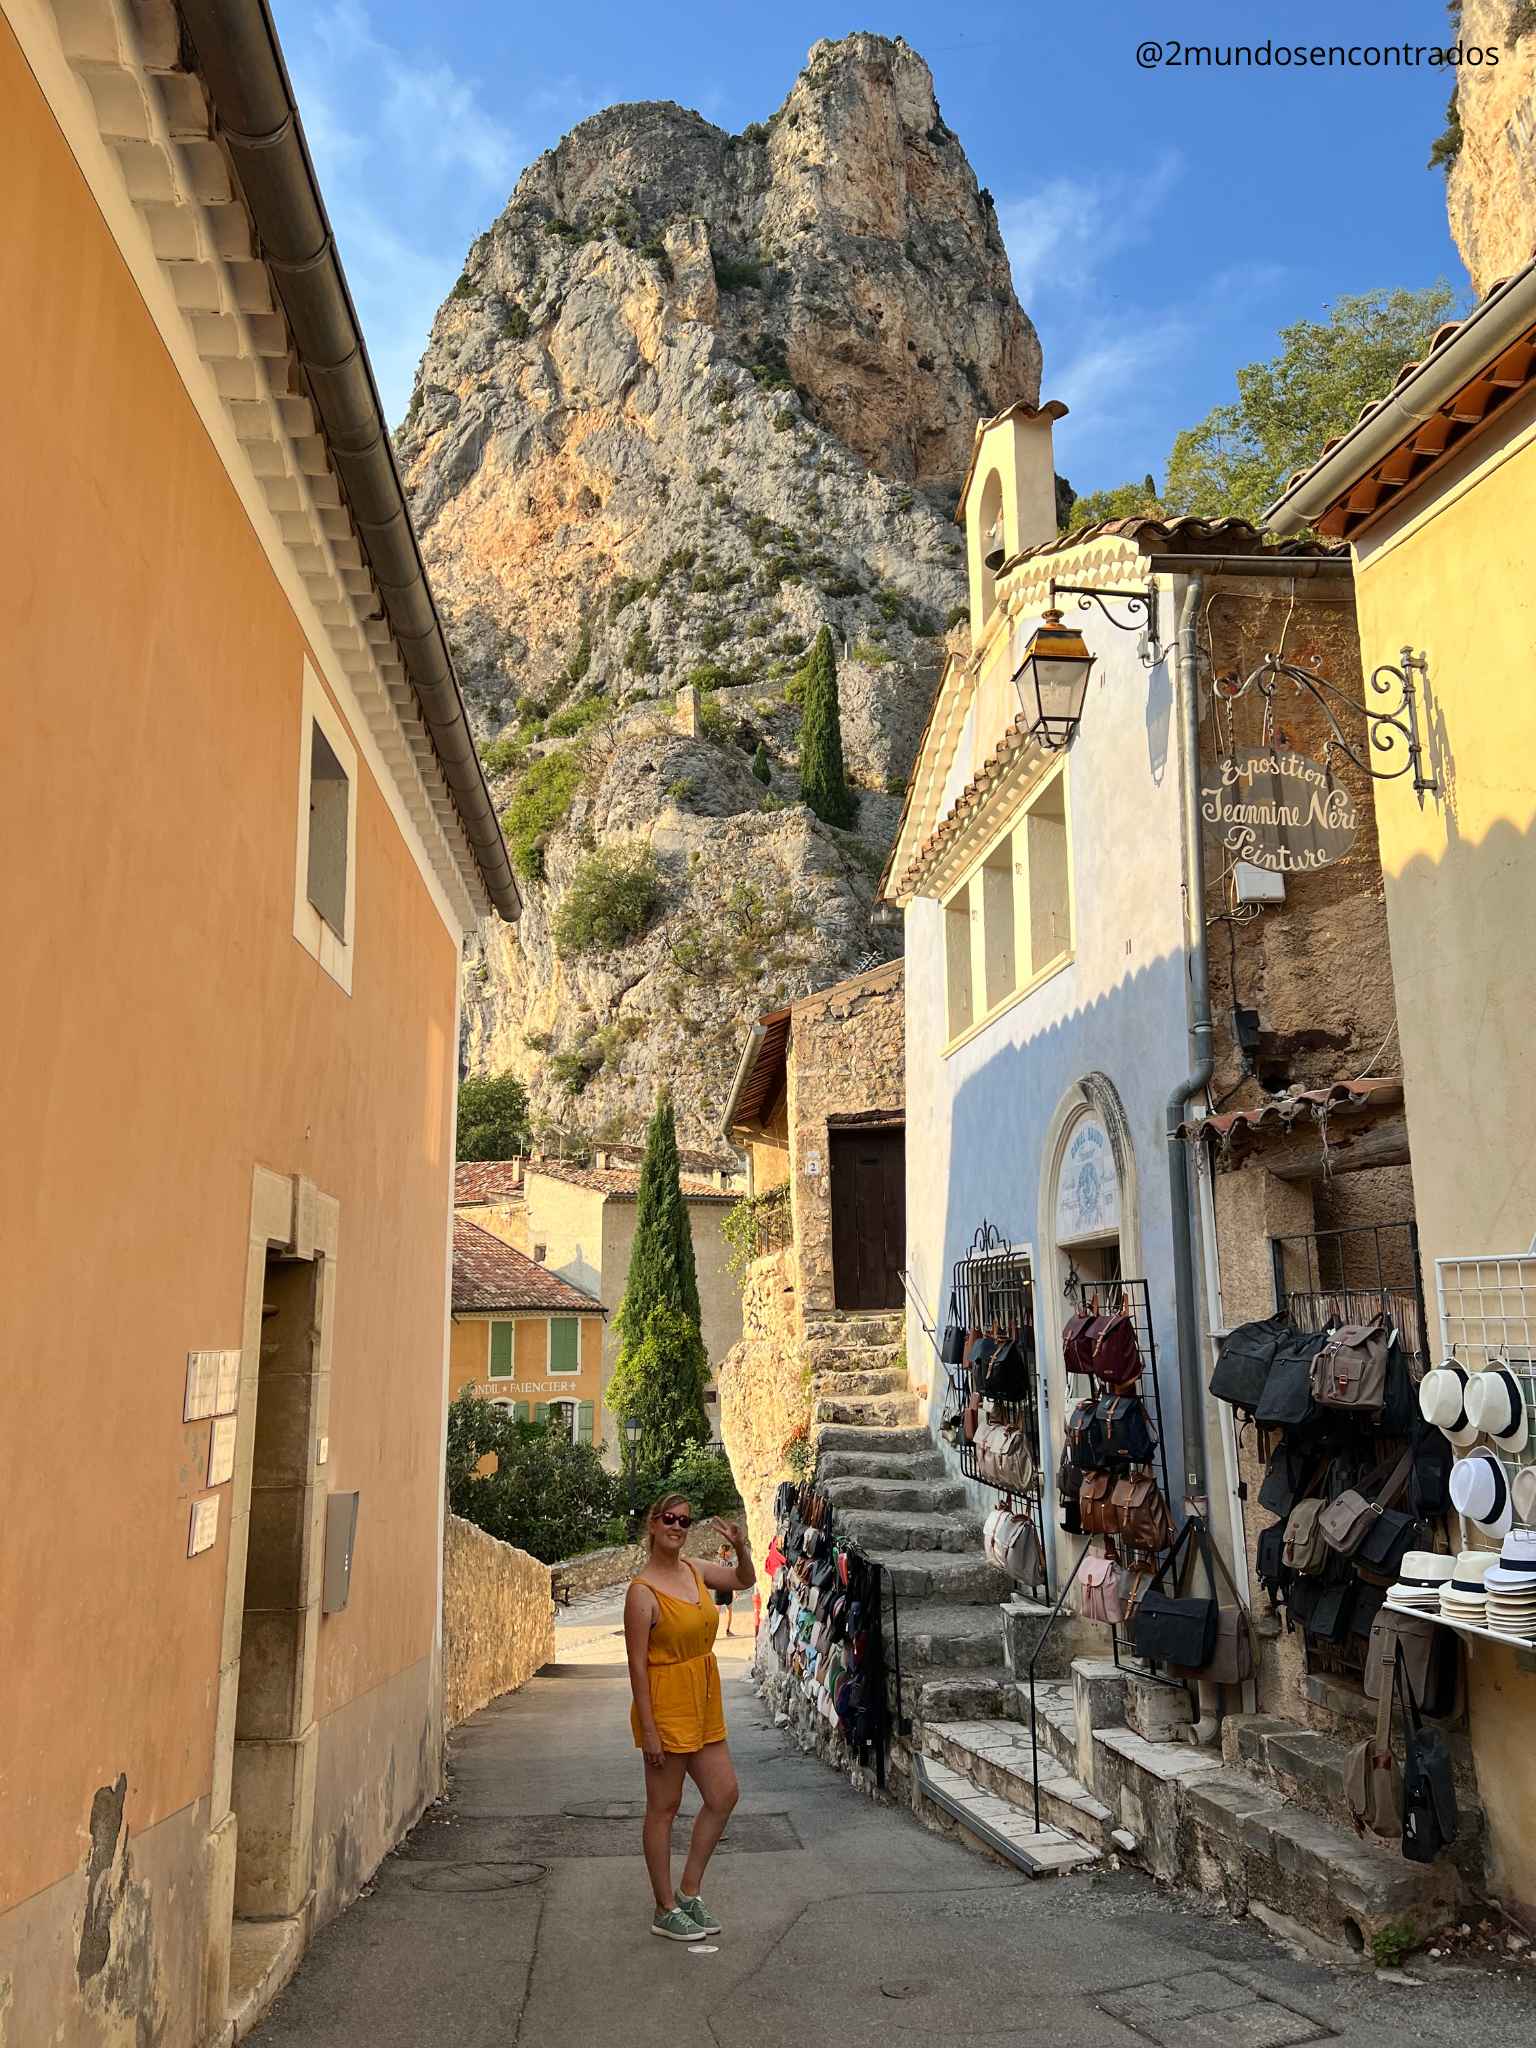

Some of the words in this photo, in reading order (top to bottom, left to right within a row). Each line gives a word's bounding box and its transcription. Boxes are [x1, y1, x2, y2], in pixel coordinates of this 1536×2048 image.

[1220, 754, 1328, 789] Exposition
[1201, 787, 1302, 827] Jeannine
[1223, 825, 1333, 871] Peinture
